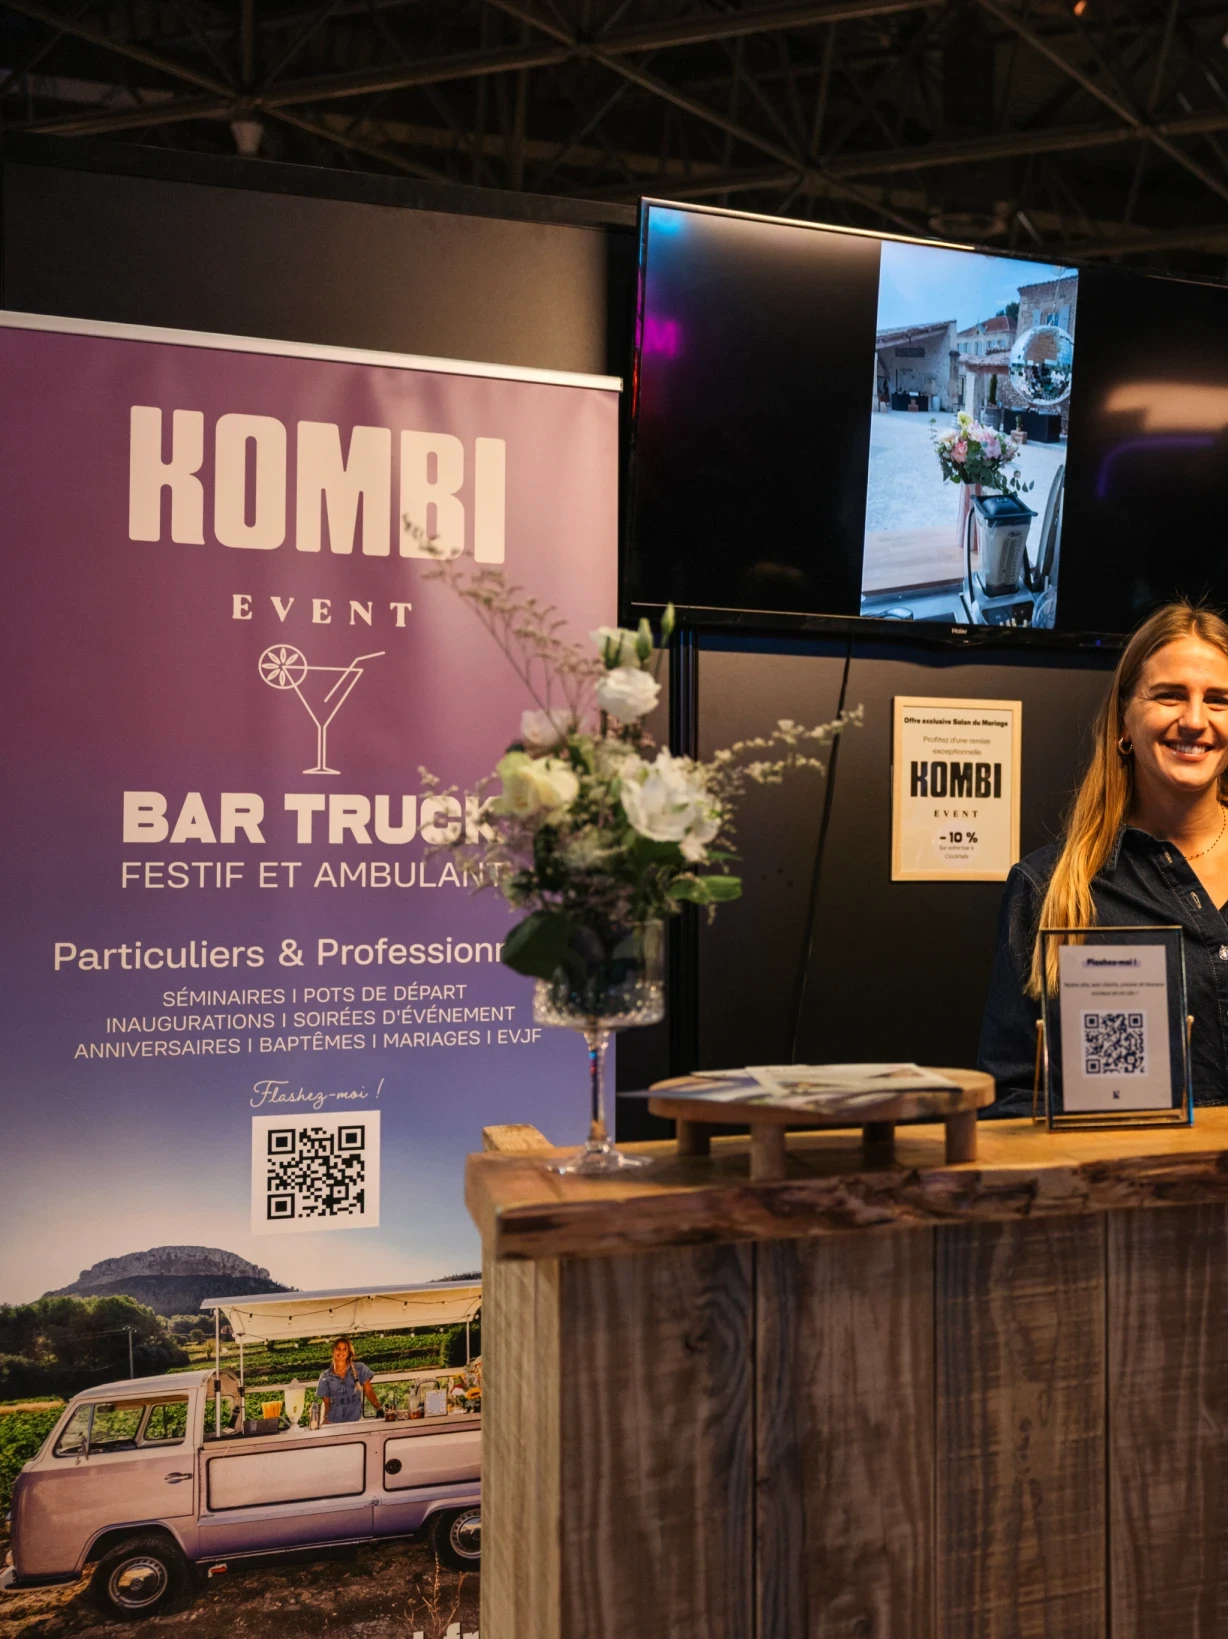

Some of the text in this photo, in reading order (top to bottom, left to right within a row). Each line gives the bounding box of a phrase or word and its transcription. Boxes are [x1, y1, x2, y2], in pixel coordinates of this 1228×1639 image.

[129, 405, 506, 563] KOMBI
[232, 594, 412, 628] EVENT
[982, 720, 1008, 728] Mariage
[923, 736, 949, 744] Profitez
[932, 748, 982, 756] exceptionnelle
[910, 761, 1002, 798] KOMBI
[123, 791, 505, 845] BAR TRUCK
[934, 809, 979, 818] EVENT
[121, 861, 505, 888] FESTIF ET AMBULANT
[54, 940, 265, 970] Particuliers
[278, 939, 304, 966] &
[162, 987, 285, 1007] SÉMINAIRES
[304, 987, 355, 1003] POTS
[362, 986, 387, 1002] DE
[394, 982, 467, 1001] DÉPART
[106, 1013, 275, 1033] INAUGURATIONS
[294, 1007, 376, 1027] SOIRÉES
[383, 1004, 515, 1025] D'ÉVÉNEMENT
[74, 1038, 241, 1059] ANNIVERSAIRES
[260, 1031, 366, 1053] BAPTÊMES
[384, 1030, 480, 1048] MARIAGES
[498, 1028, 542, 1044] EVJF
